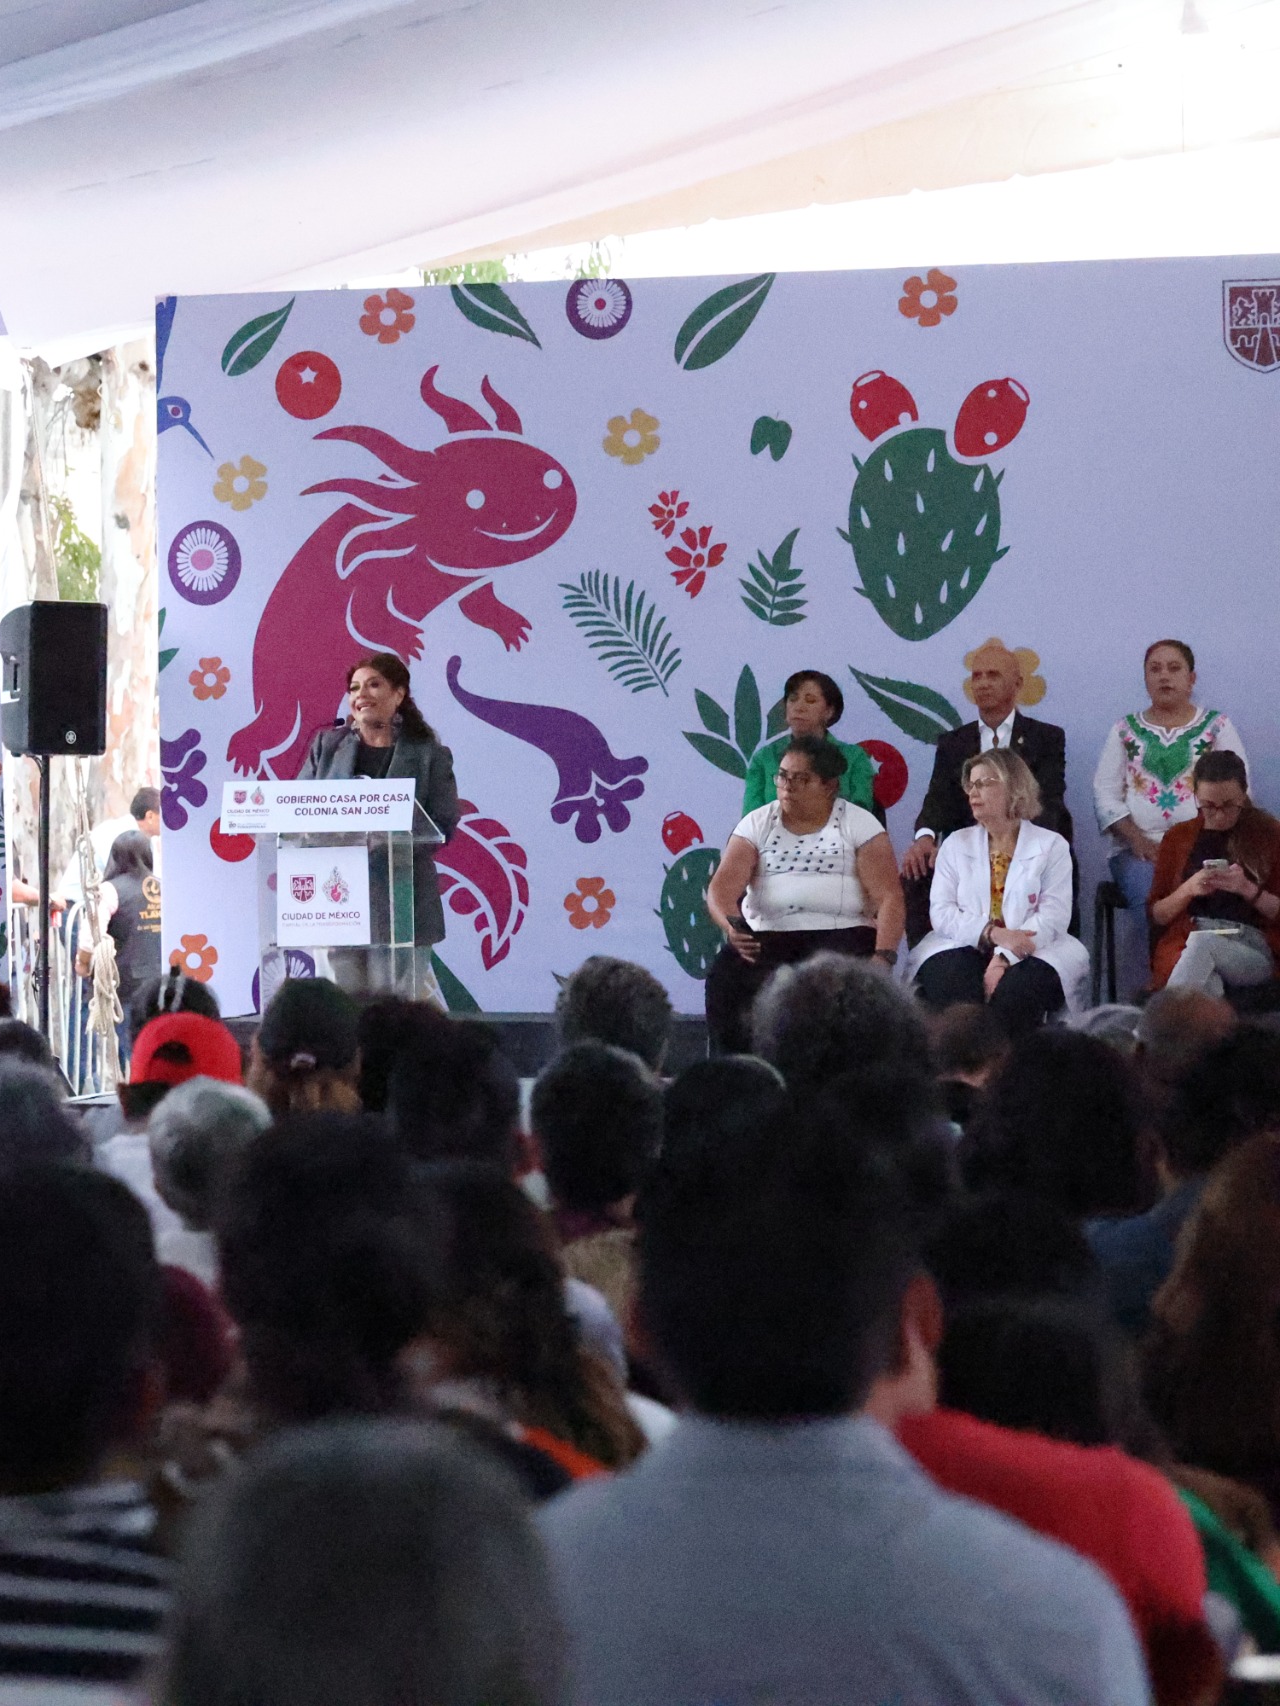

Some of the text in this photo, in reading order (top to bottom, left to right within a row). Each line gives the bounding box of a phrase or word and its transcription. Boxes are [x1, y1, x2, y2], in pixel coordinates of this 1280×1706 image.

[276, 793, 411, 804] GOBIERNO CASA POR CASA
[294, 804, 391, 816] COLONIA SAN JOSÉ
[281, 910, 361, 921] CIUDAD DE MÉXICO
